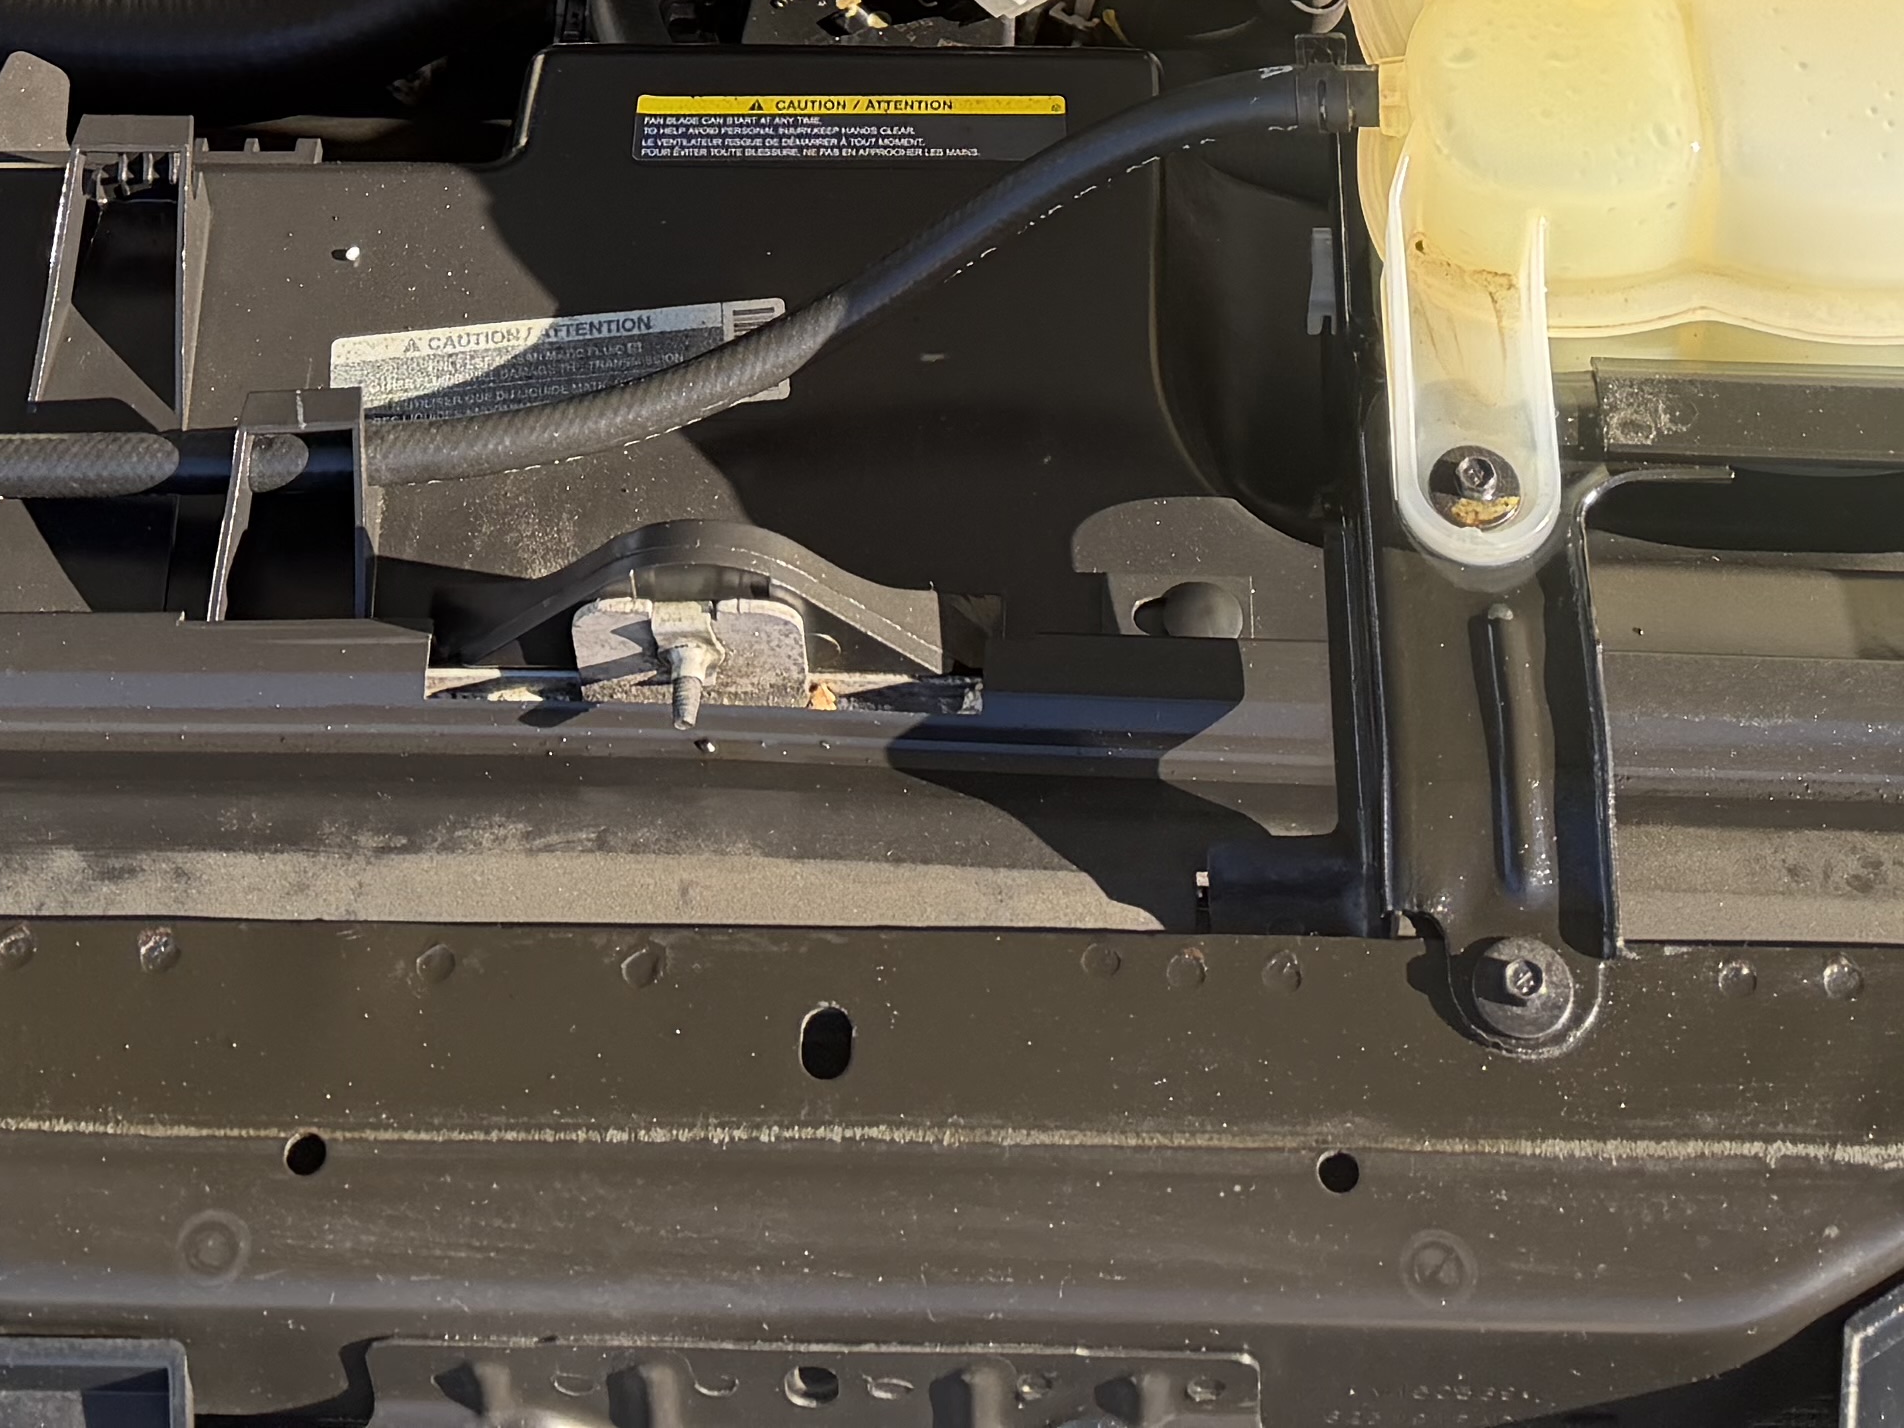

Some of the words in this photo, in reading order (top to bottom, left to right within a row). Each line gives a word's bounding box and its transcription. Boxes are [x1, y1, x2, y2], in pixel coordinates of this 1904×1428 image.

[775, 99, 846, 111] CAUTION
[865, 99, 953, 112] ATTENTION
[644, 117, 664, 125] FAN
[701, 117, 723, 125] CAN
[773, 117, 794, 125] ANY
[643, 127, 657, 135] TO
[659, 127, 686, 135] HELP
[687, 127, 719, 135] AVOID
[721, 127, 775, 135] PERSONAL
[841, 127, 877, 135] HANDS
[642, 138, 654, 146] LE
[657, 138, 722, 146] VENTILATEUR
[765, 138, 780, 146] DE
[851, 138, 875, 146] TOUT
[641, 149, 670, 157] POUR
[710, 149, 742, 157] TOUTE
[803, 149, 817, 157] NE
[819, 149, 839, 157] PAS
[842, 148, 856, 157] EN
[858, 148, 922, 157] APPROCHER
[925, 148, 943, 157] LES
[428, 328, 520, 351] CAUTION
[542, 315, 653, 340] ATTENTION
